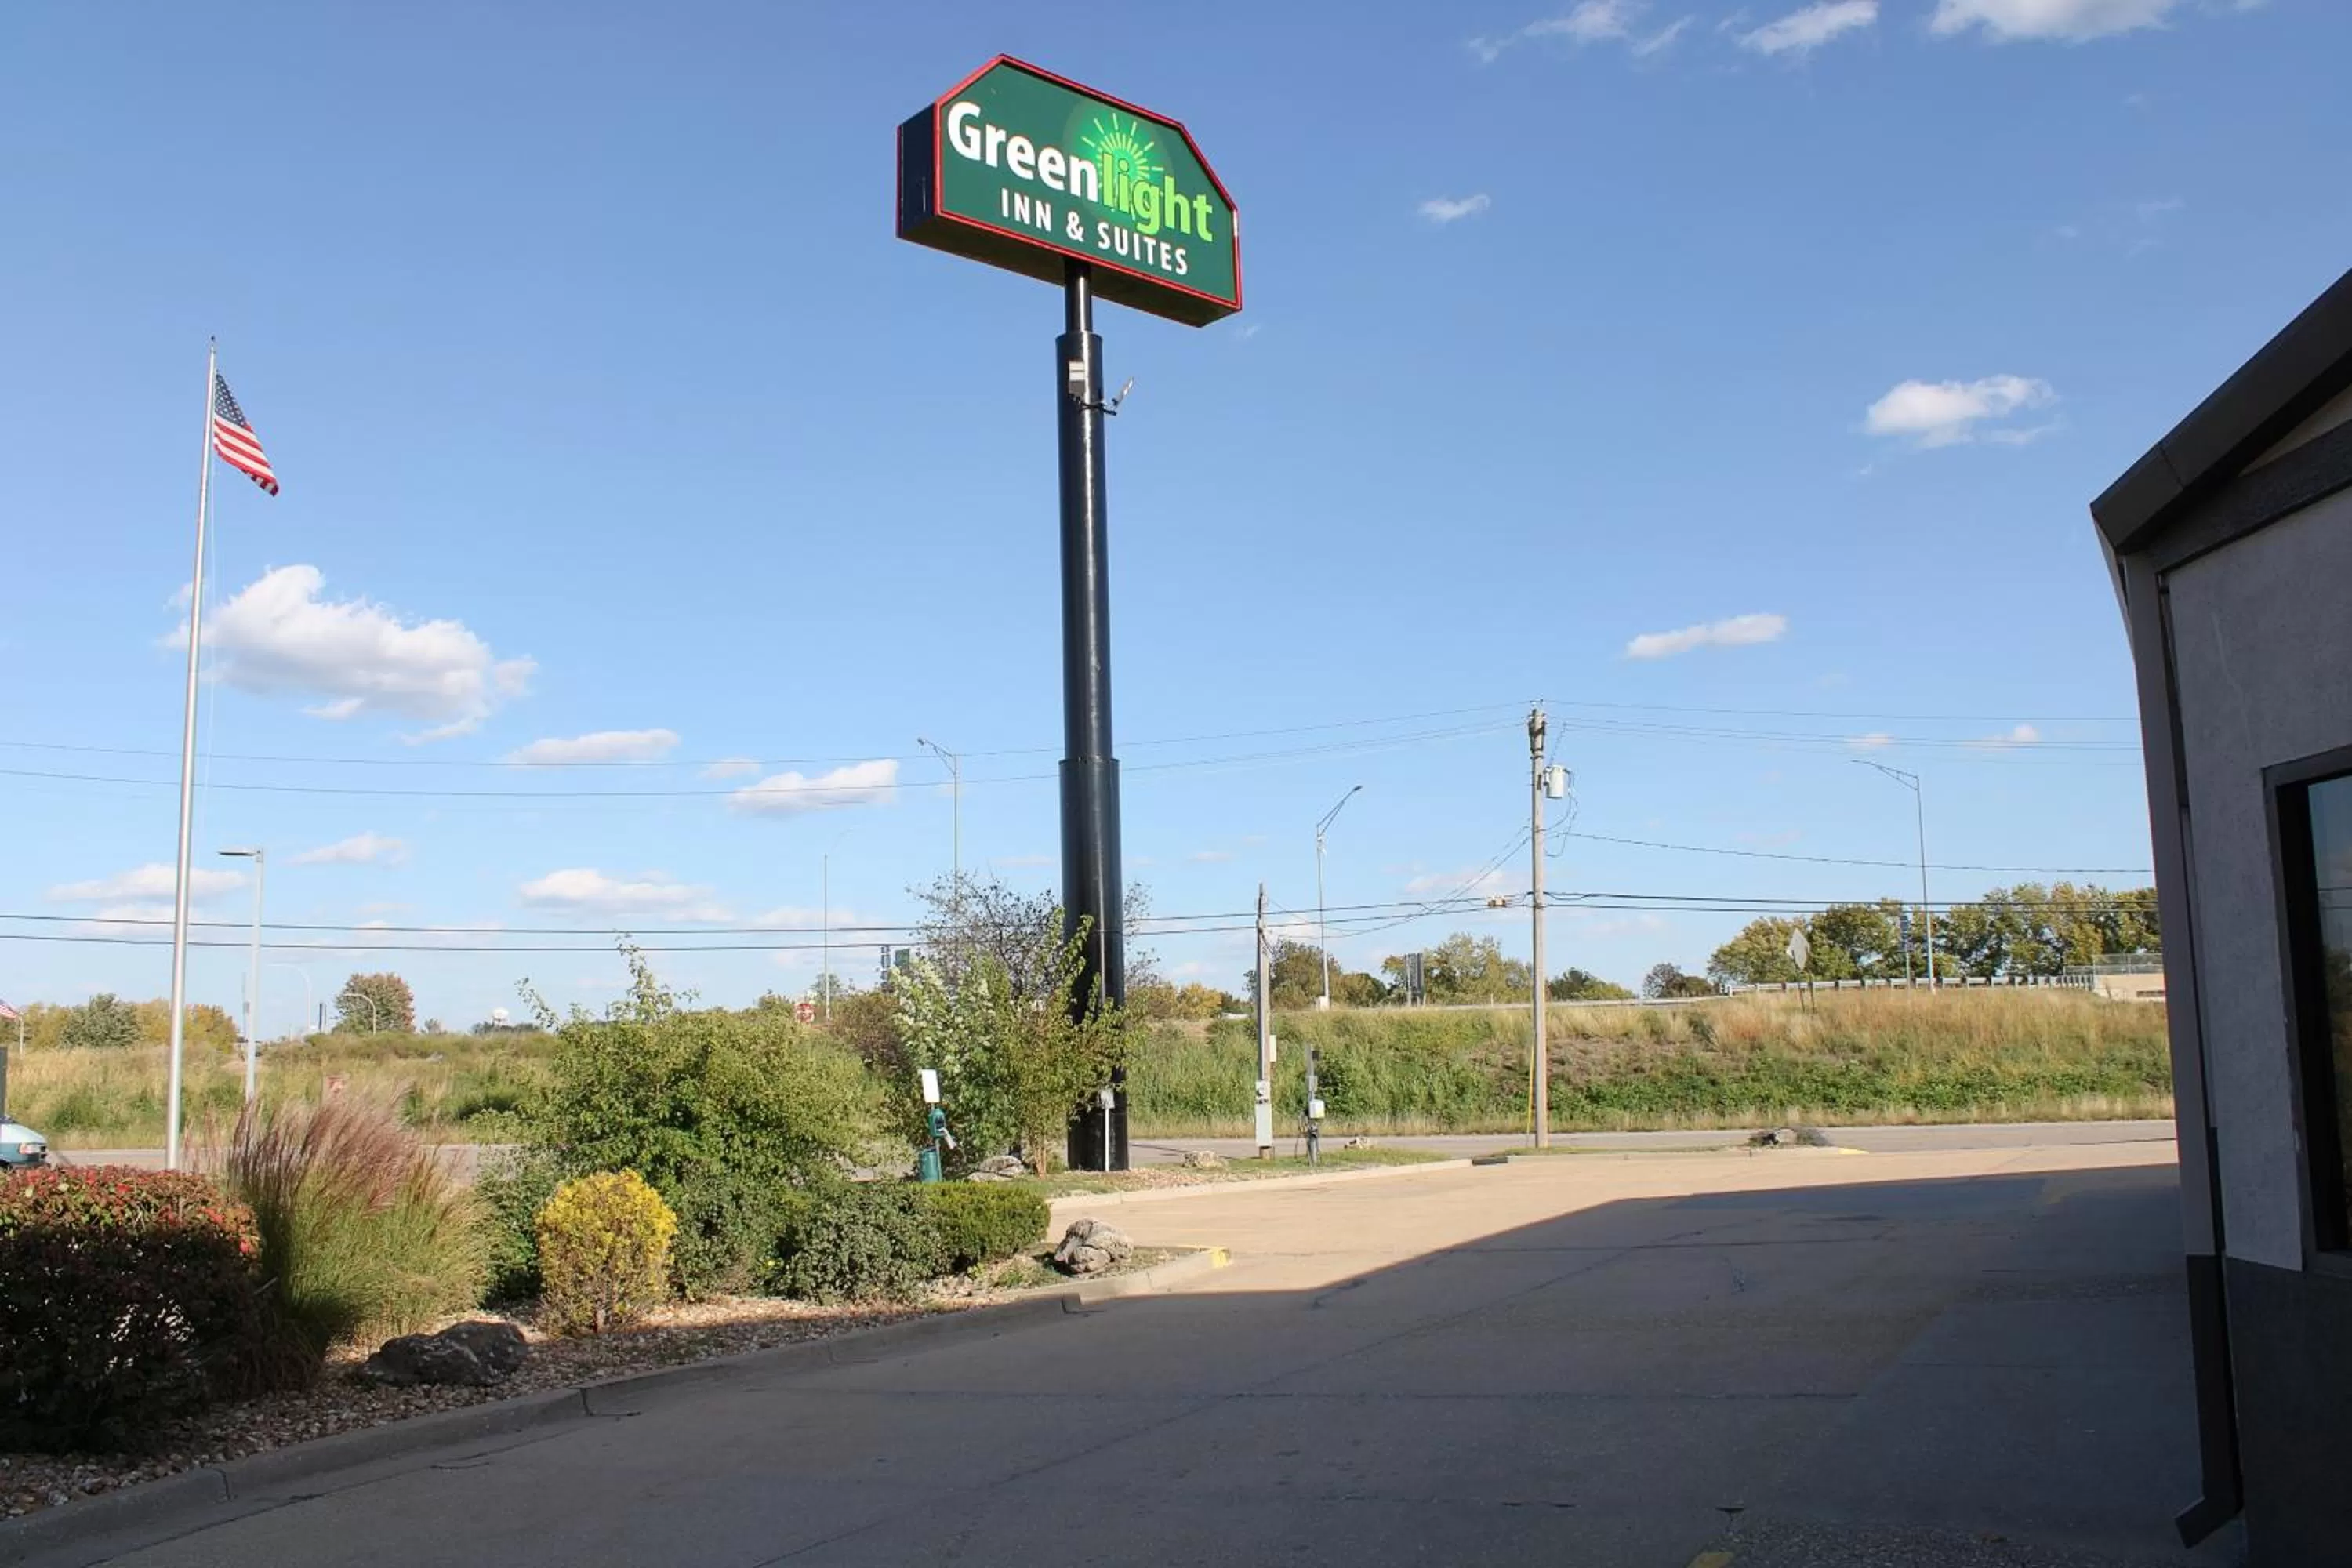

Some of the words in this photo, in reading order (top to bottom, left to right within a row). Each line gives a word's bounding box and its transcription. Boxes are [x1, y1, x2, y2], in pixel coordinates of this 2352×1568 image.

[947, 101, 1213, 242] Greenlight
[1001, 187, 1052, 232] INN
[1065, 211, 1084, 242] &
[1097, 221, 1189, 275] SUITES
